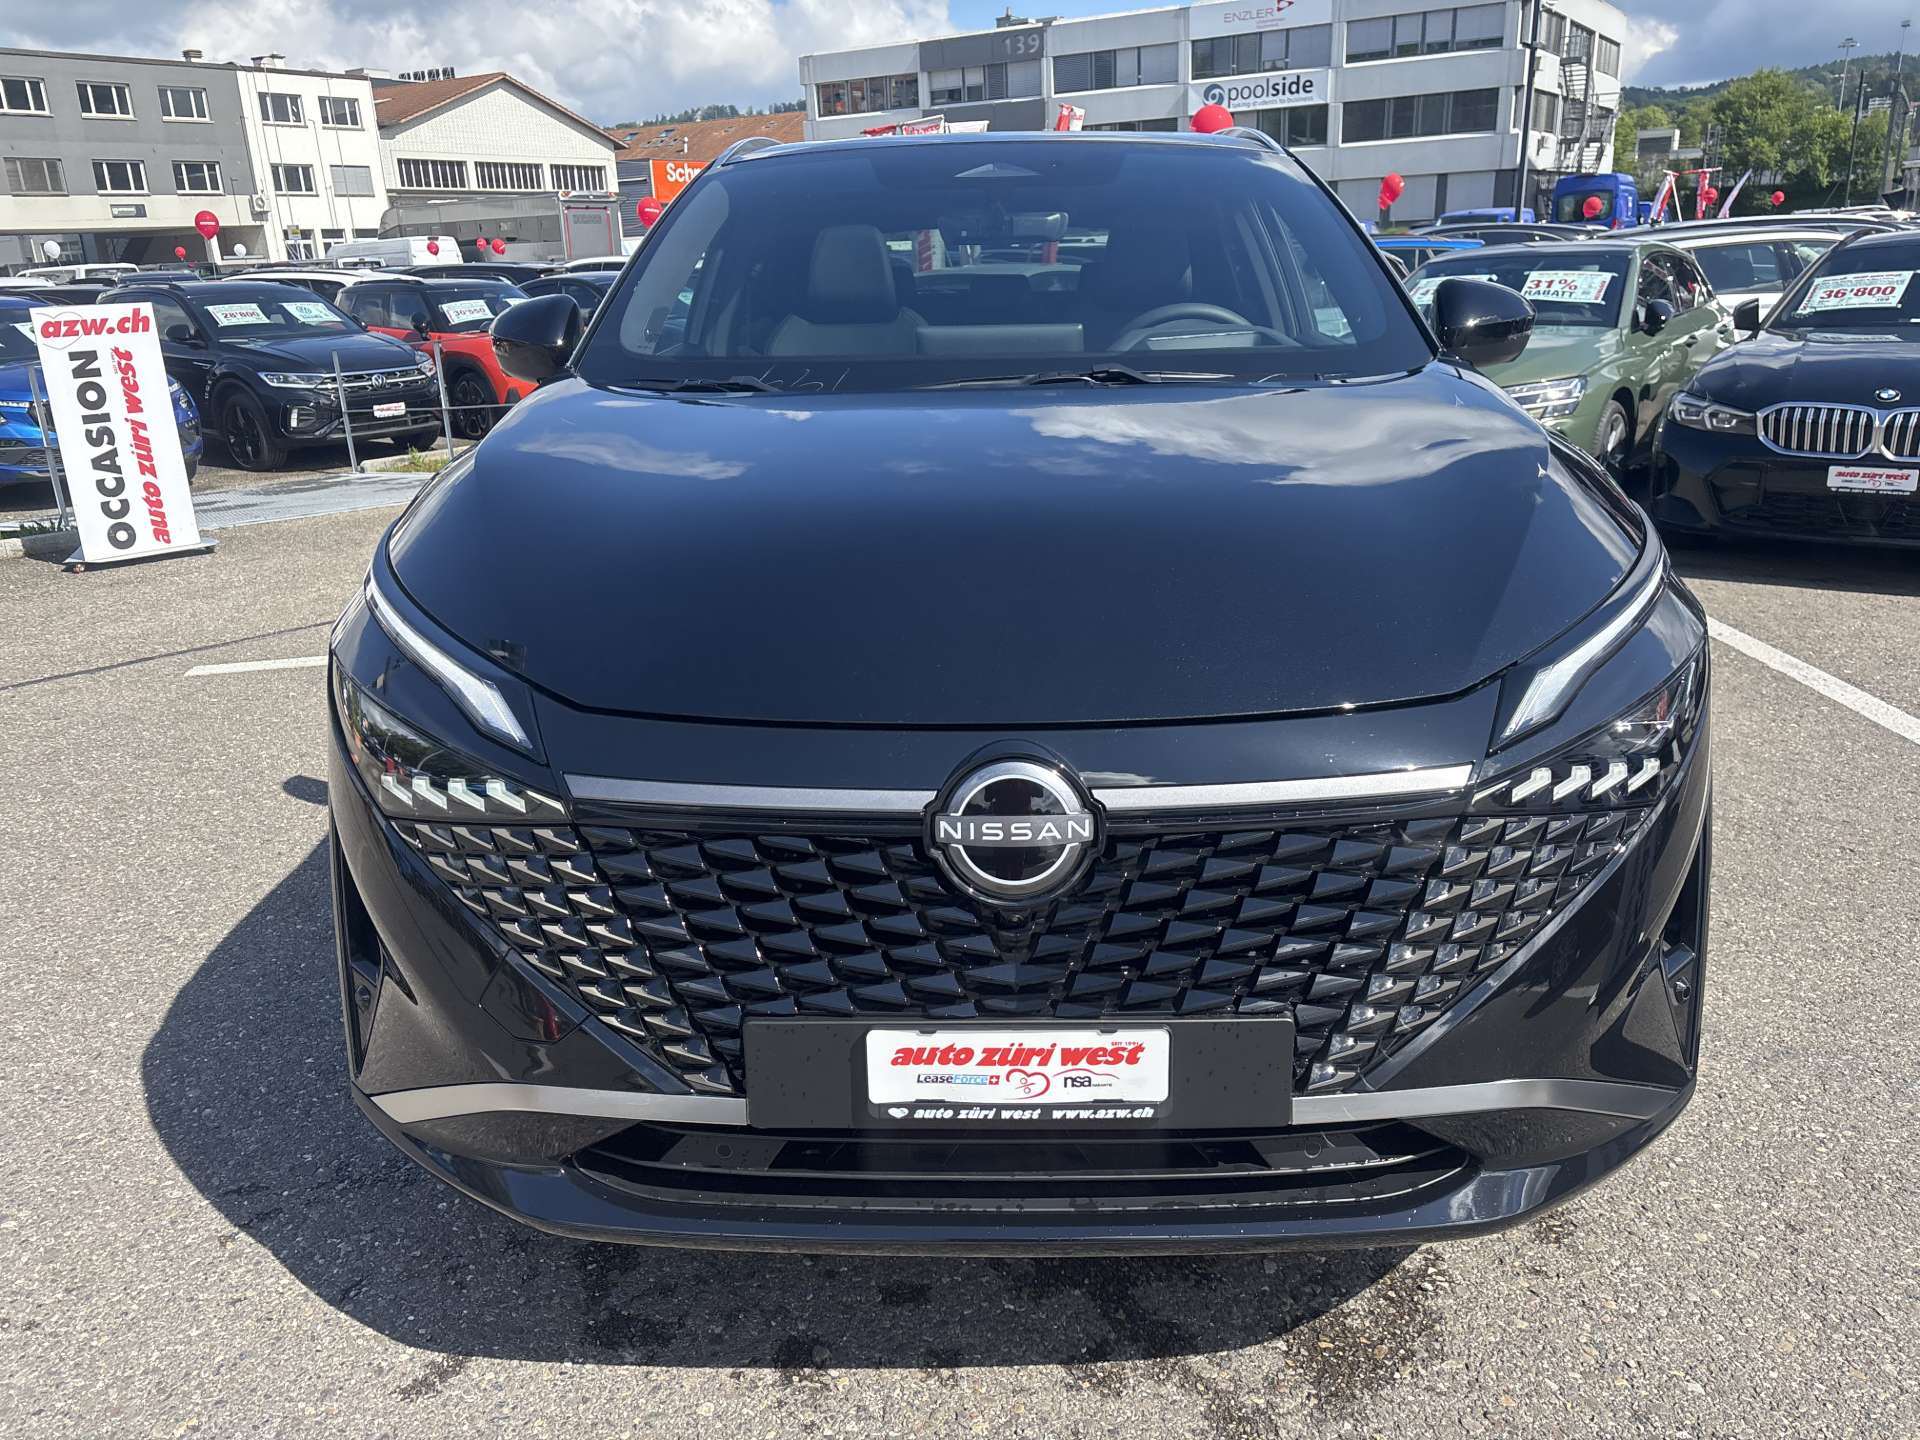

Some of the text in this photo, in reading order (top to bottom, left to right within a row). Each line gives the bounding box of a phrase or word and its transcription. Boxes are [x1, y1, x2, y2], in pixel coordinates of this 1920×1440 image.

[1223, 8, 1274, 23] ENZLER
[1005, 34, 1039, 55] 139
[1228, 75, 1314, 108] poolside
[1524, 290, 1577, 298] RABATT
[1527, 279, 1578, 291] 31%
[1820, 286, 1896, 299] 36'800
[41, 308, 150, 338] azw.ch
[68, 350, 136, 550] OCCASION
[112, 346, 172, 545] auto züri west
[939, 819, 1090, 841] NISSAN
[891, 1043, 1146, 1066] auto züri west
[917, 1074, 988, 1085] LeaseForce
[1064, 1076, 1091, 1088] nsa
[914, 1107, 1154, 1119] auto züri west www.azw.ch
